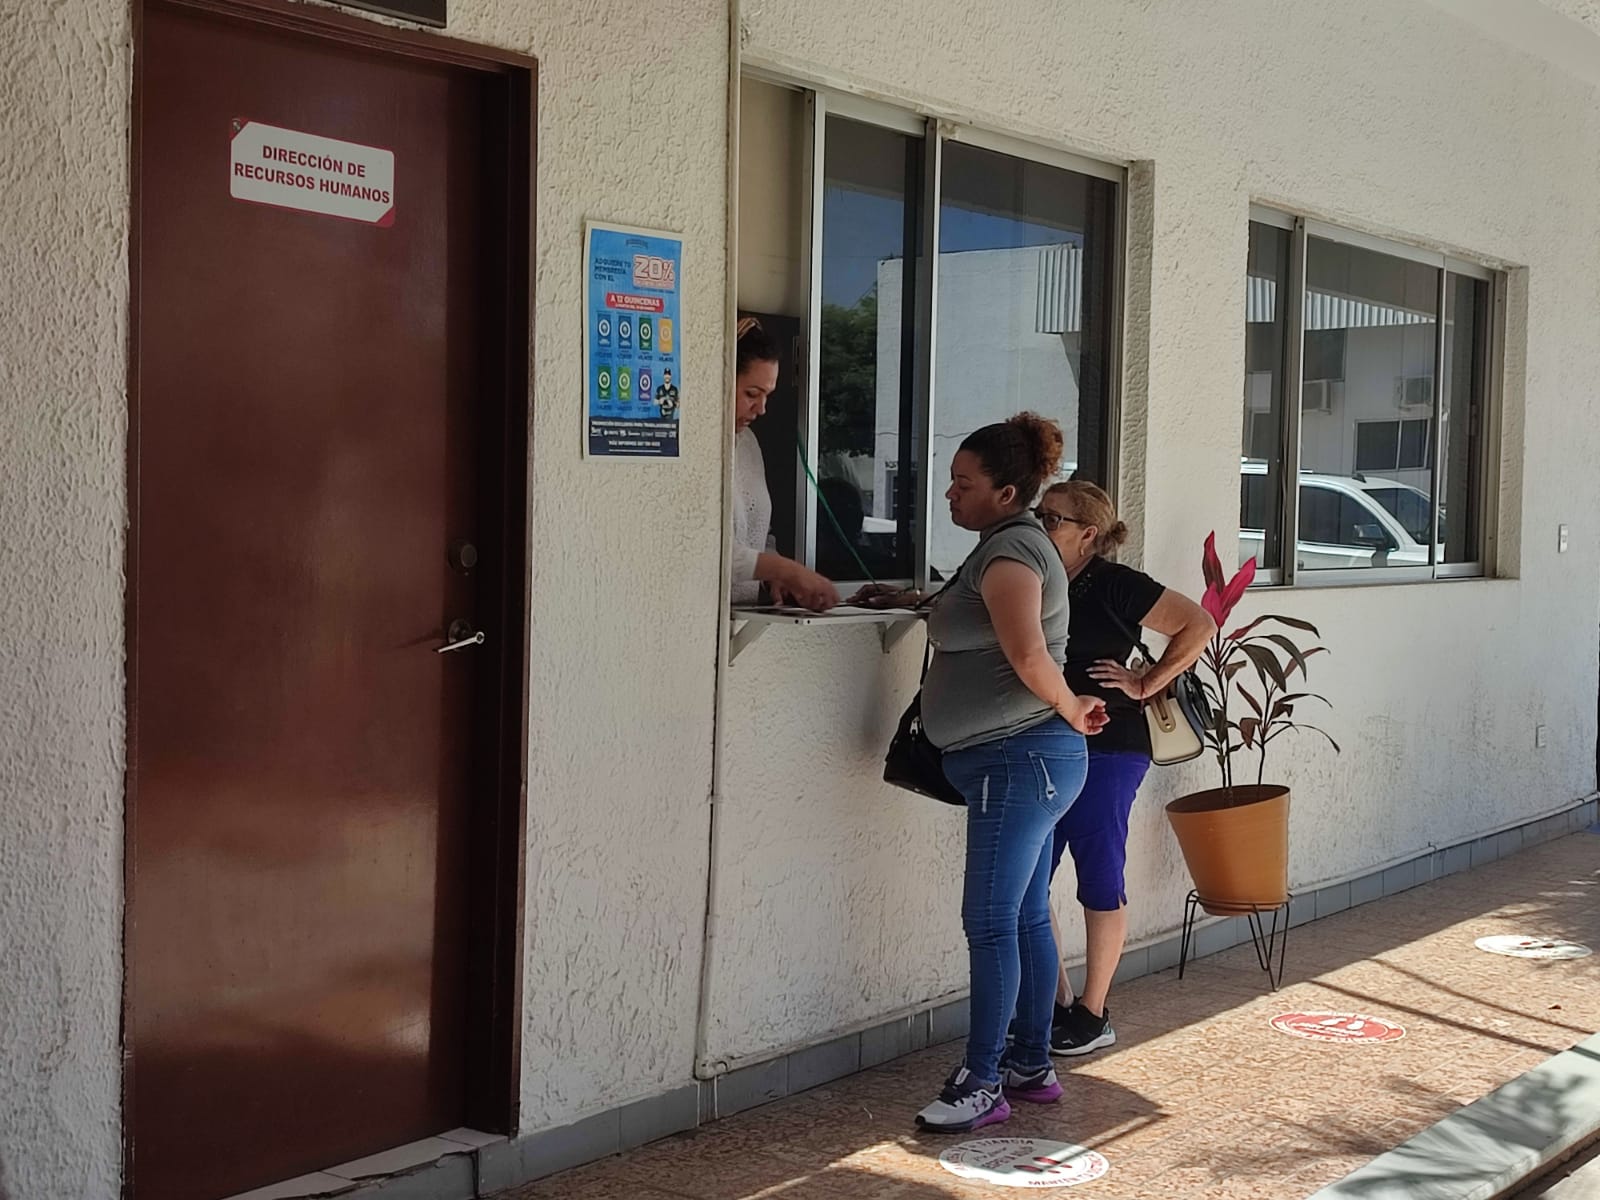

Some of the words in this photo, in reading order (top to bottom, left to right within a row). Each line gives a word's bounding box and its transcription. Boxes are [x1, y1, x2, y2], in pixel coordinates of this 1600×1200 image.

[263, 145, 342, 173] DIRECCIÓN
[347, 163, 366, 177] DE
[234, 162, 315, 190] RECURSOS
[319, 178, 391, 204] HUMANOS
[594, 273, 607, 281] CON
[633, 254, 675, 282] 20%
[610, 294, 616, 302] A
[624, 295, 660, 307] QUINCENAS
